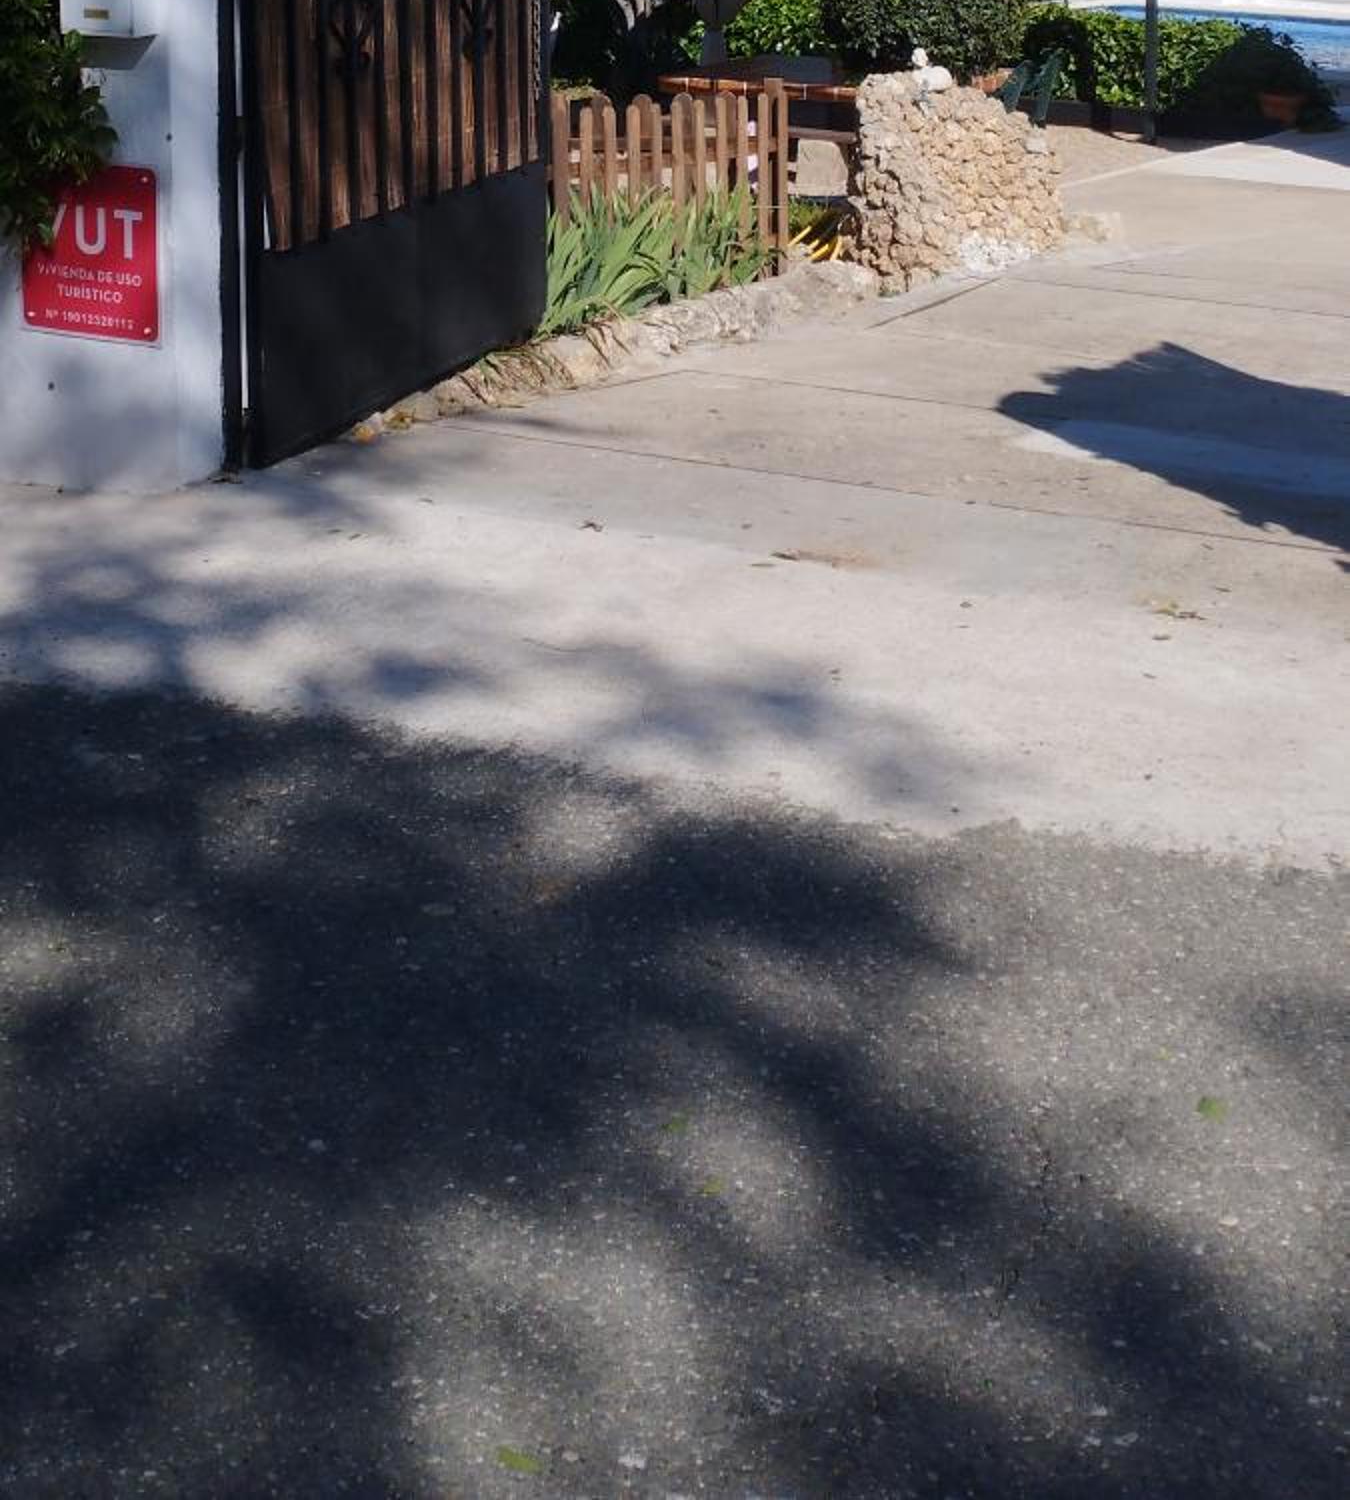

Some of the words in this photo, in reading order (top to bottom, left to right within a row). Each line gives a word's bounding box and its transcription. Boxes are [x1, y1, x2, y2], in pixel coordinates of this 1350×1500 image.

[38, 262, 95, 281] VIVIENDA
[97, 270, 113, 283] DE
[115, 272, 142, 287] USO
